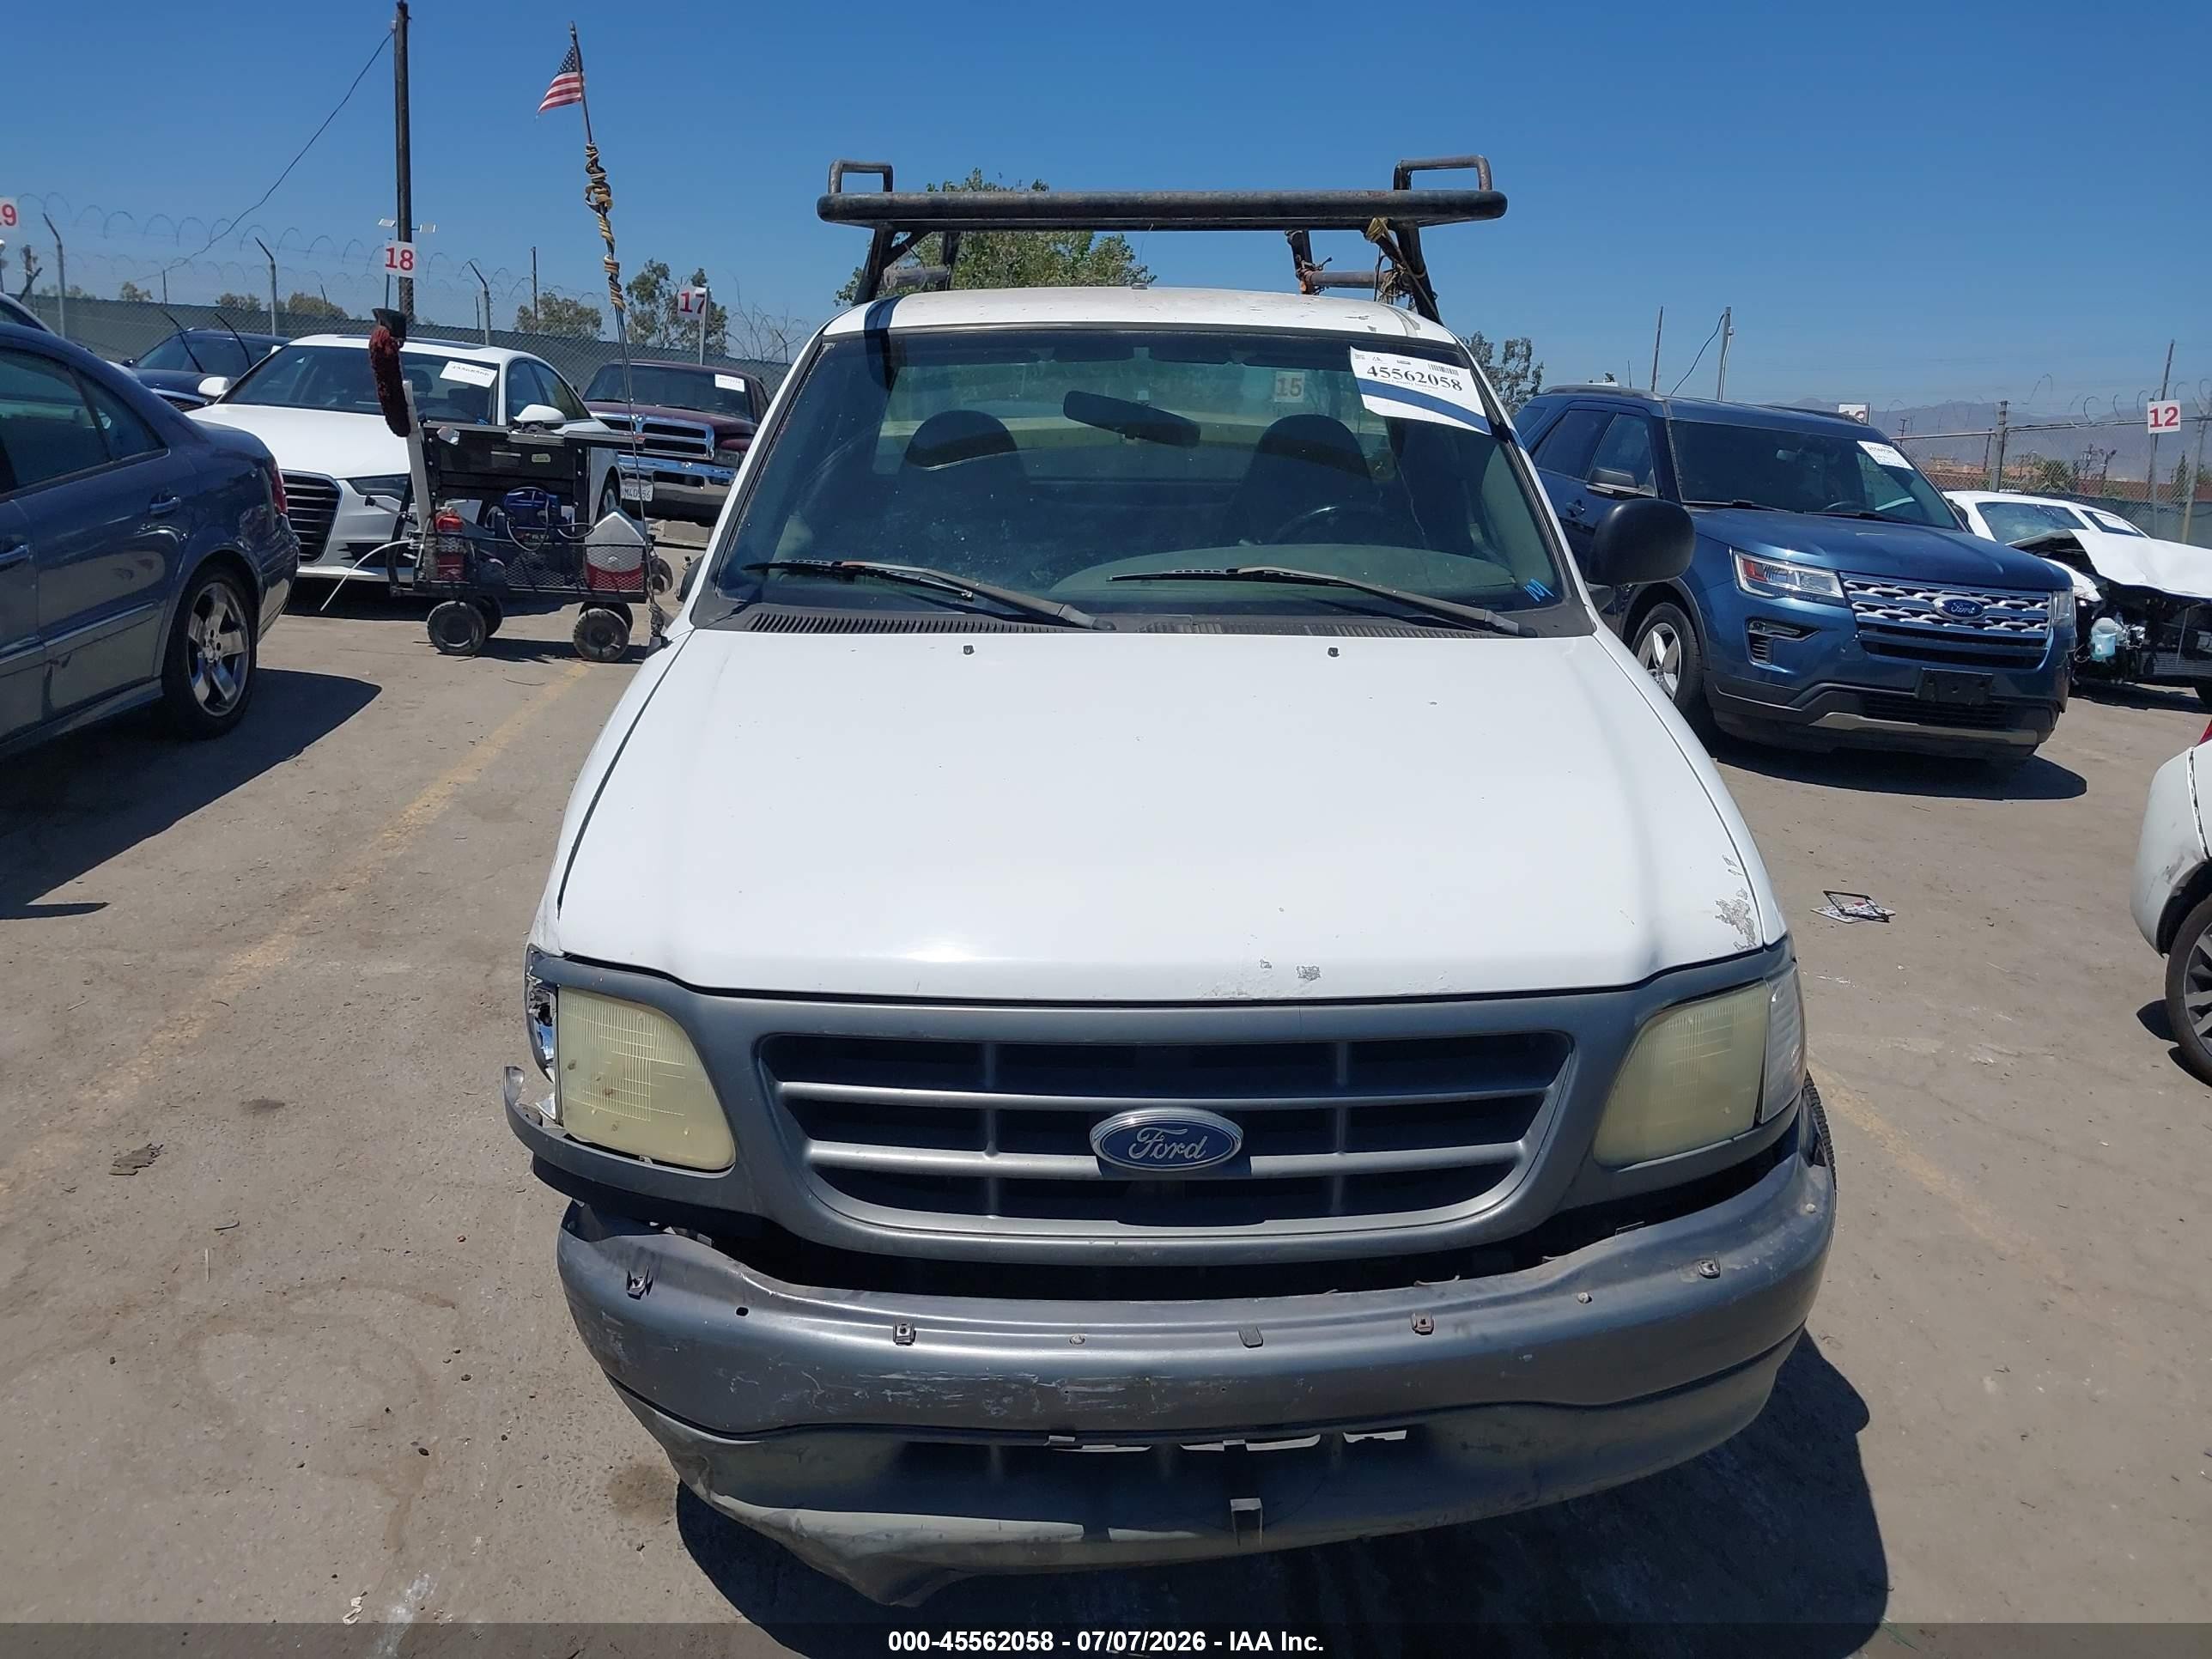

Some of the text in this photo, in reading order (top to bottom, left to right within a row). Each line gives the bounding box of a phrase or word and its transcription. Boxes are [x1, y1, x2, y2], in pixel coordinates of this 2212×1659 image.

[0, 204, 17, 226] 9
[385, 247, 414, 270] 18
[680, 292, 705, 314] 17
[1277, 377, 1302, 397] 15
[1367, 366, 1462, 392] 45562058
[2149, 406, 2179, 428] 12
[1128, 1127, 1207, 1159] Ford
